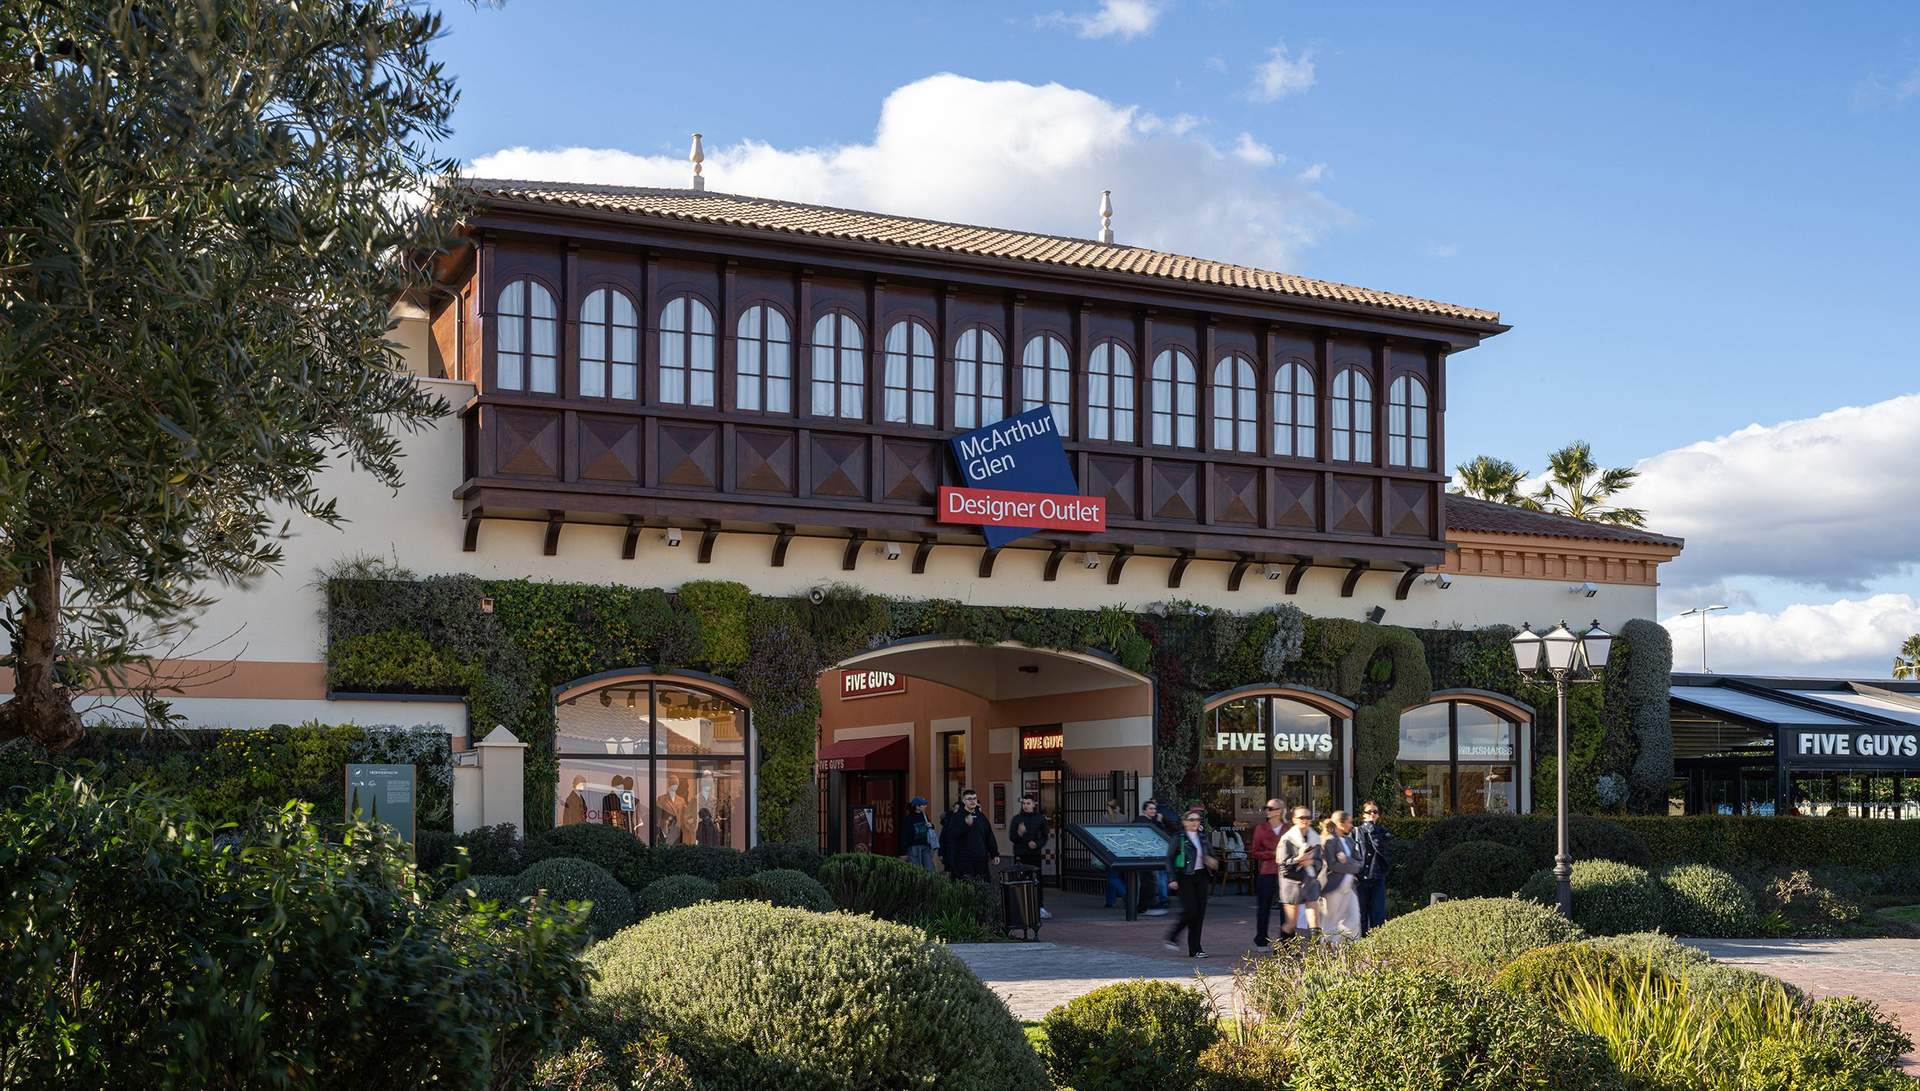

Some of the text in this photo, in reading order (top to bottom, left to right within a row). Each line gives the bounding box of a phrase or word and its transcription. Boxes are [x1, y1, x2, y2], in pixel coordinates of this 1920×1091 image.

[959, 415, 1051, 461] McArthur
[968, 453, 1016, 481] Glen
[949, 492, 1100, 523] Designer Outlet
[845, 671, 896, 692] FIVE GUYS
[1023, 737, 1043, 750] FIVE
[1217, 732, 1333, 752] FIVE GUYS
[1799, 733, 1918, 756] FIVE GUYS
[829, 759, 845, 770] GUYS
[876, 817, 894, 834] UYS
